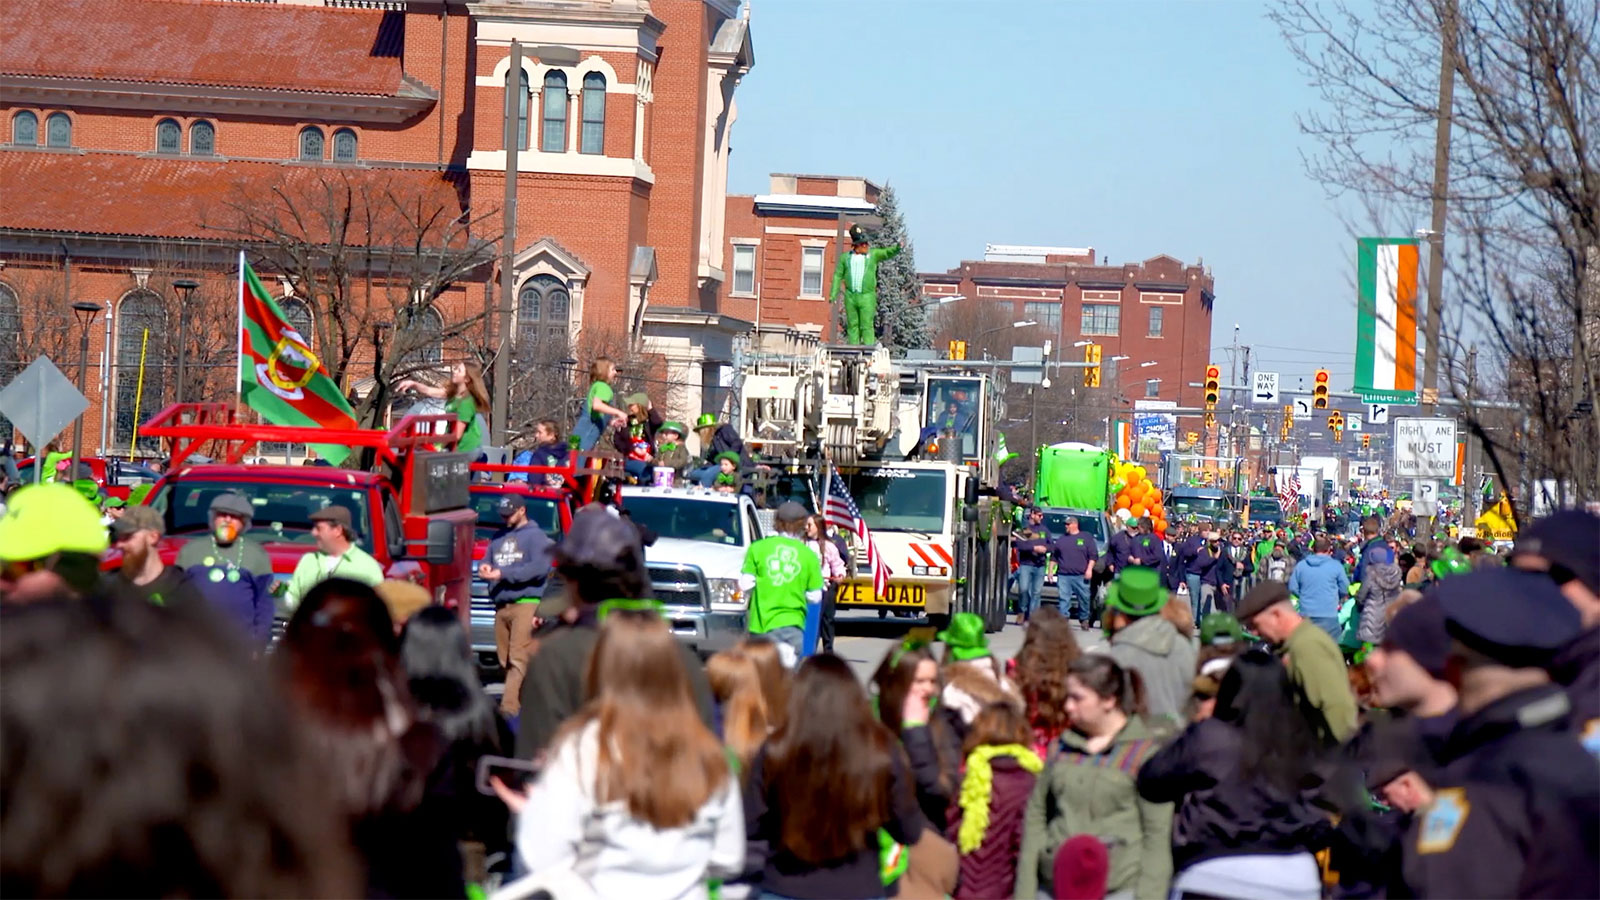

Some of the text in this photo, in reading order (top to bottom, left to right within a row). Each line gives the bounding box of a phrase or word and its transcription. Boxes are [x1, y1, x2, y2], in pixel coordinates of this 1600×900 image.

[1400, 426, 1423, 435] RIGHT
[1409, 443, 1442, 453] MUST
[1399, 460, 1452, 469] TURN RIGHT
[874, 584, 923, 603] LOAD
